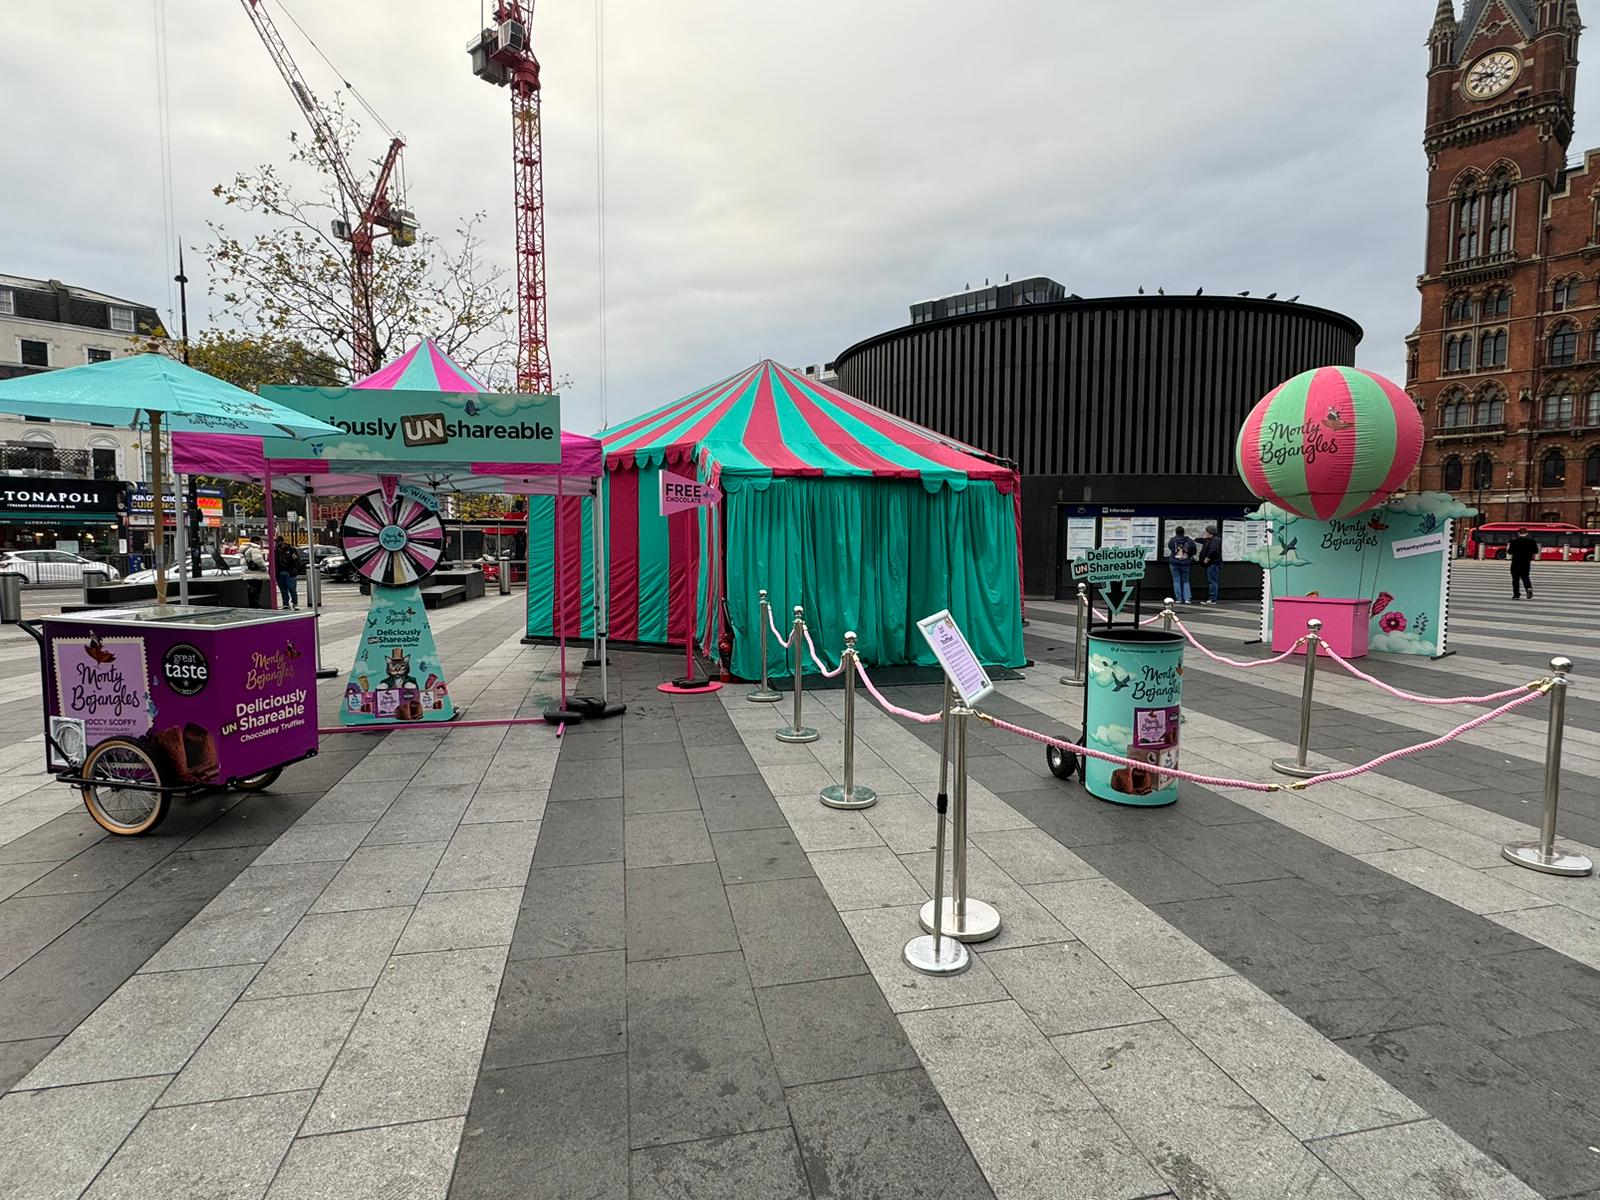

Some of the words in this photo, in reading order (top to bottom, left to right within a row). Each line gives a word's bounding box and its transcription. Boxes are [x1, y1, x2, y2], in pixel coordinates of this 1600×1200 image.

[311, 415, 398, 440] iously
[405, 418, 445, 442] UN
[447, 419, 554, 441] shareable
[1269, 418, 1321, 443] Monty
[1260, 434, 1338, 465] Bojangles
[0, 491, 99, 503] TONAPOLI
[665, 483, 701, 497] FREE
[1329, 519, 1366, 537] Monty
[1320, 532, 1378, 552] Bojangles
[1087, 548, 1145, 561] Deliciously
[1075, 564, 1088, 574] UN
[1089, 560, 1143, 573] Shareable
[377, 629, 421, 637] Deliciously
[173, 654, 197, 664] great
[251, 648, 285, 671] Monty
[76, 663, 124, 693] Monty
[165, 662, 207, 680] taste
[246, 662, 295, 690] Bojangles
[1141, 665, 1176, 686] Monty
[71, 685, 140, 716] Bojangles
[236, 688, 307, 717] Deliciously
[108, 718, 136, 726] SCOFFY
[222, 722, 238, 736] UN
[240, 703, 305, 731] Shareable
[280, 718, 305, 731] Truffles
